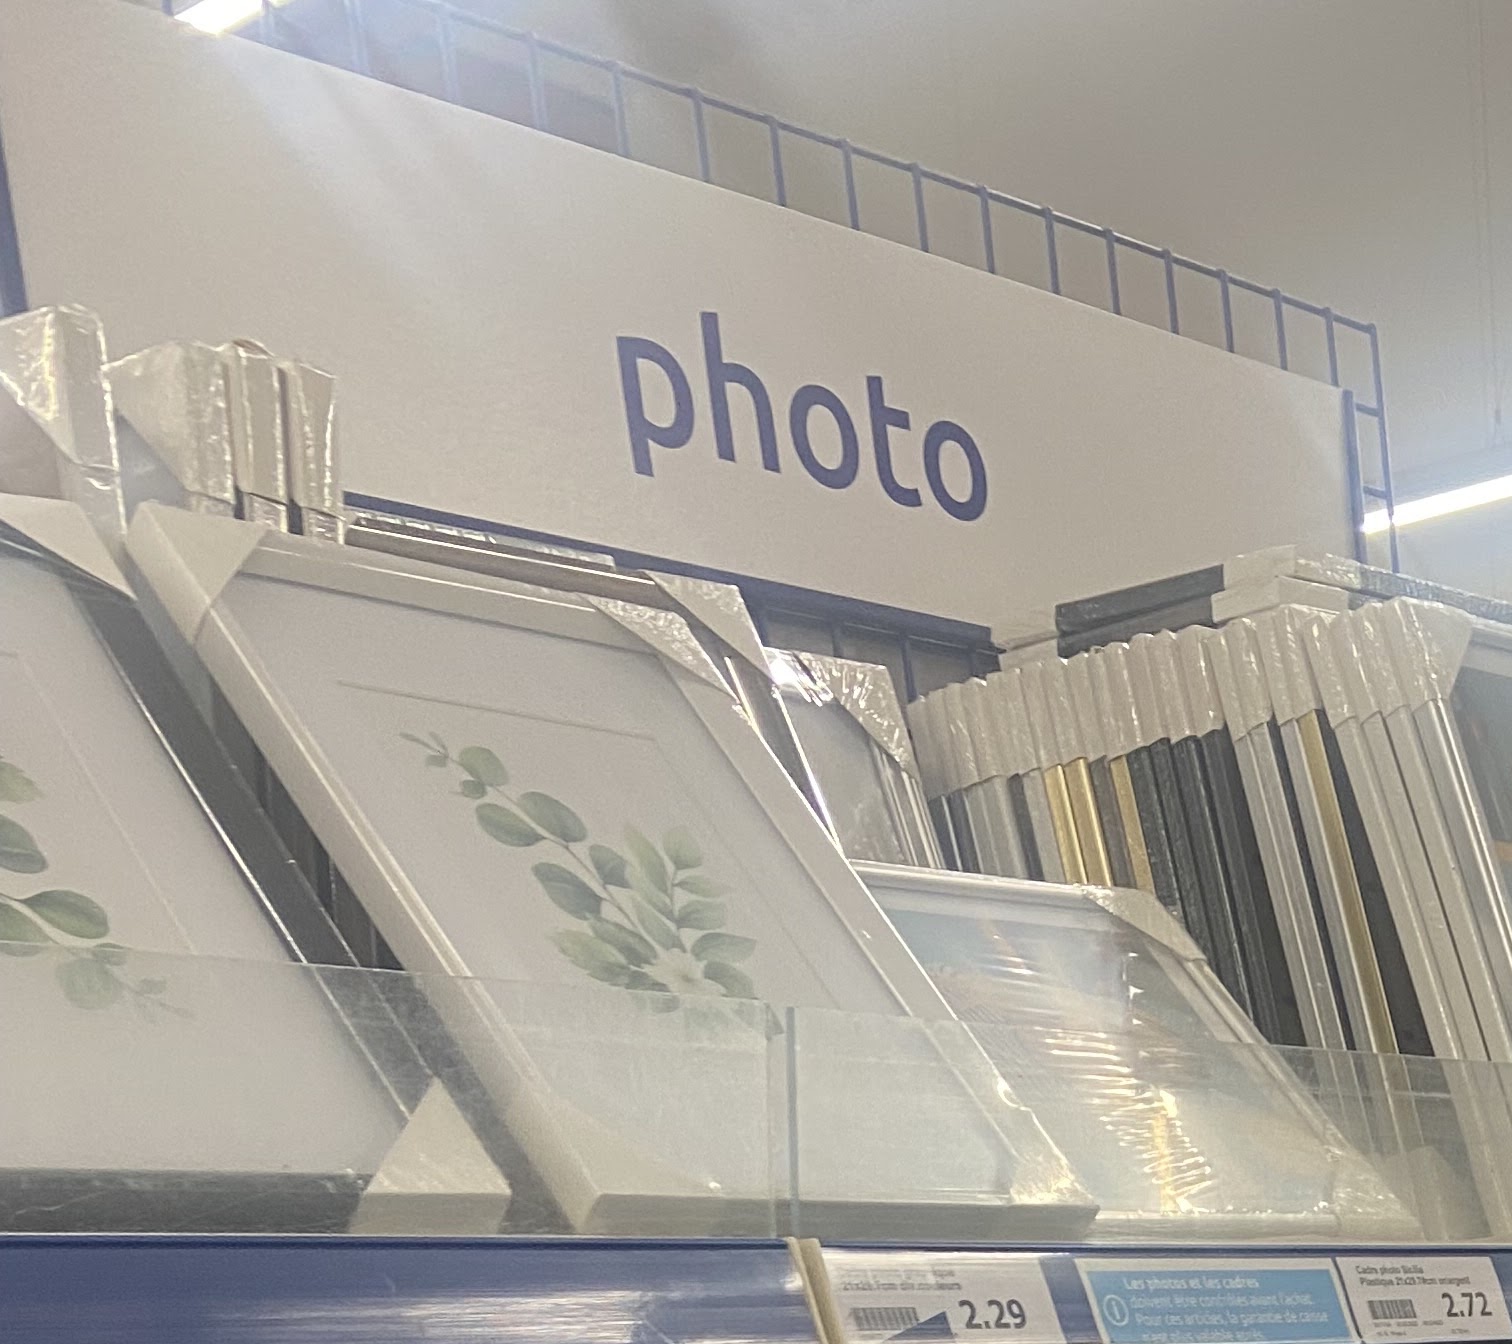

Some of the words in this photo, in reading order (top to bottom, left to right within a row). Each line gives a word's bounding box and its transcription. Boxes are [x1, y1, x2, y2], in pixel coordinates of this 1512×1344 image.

[615, 311, 988, 522] photo
[958, 1299, 1027, 1329] 2.29
[1441, 1291, 1493, 1318] 2.72
